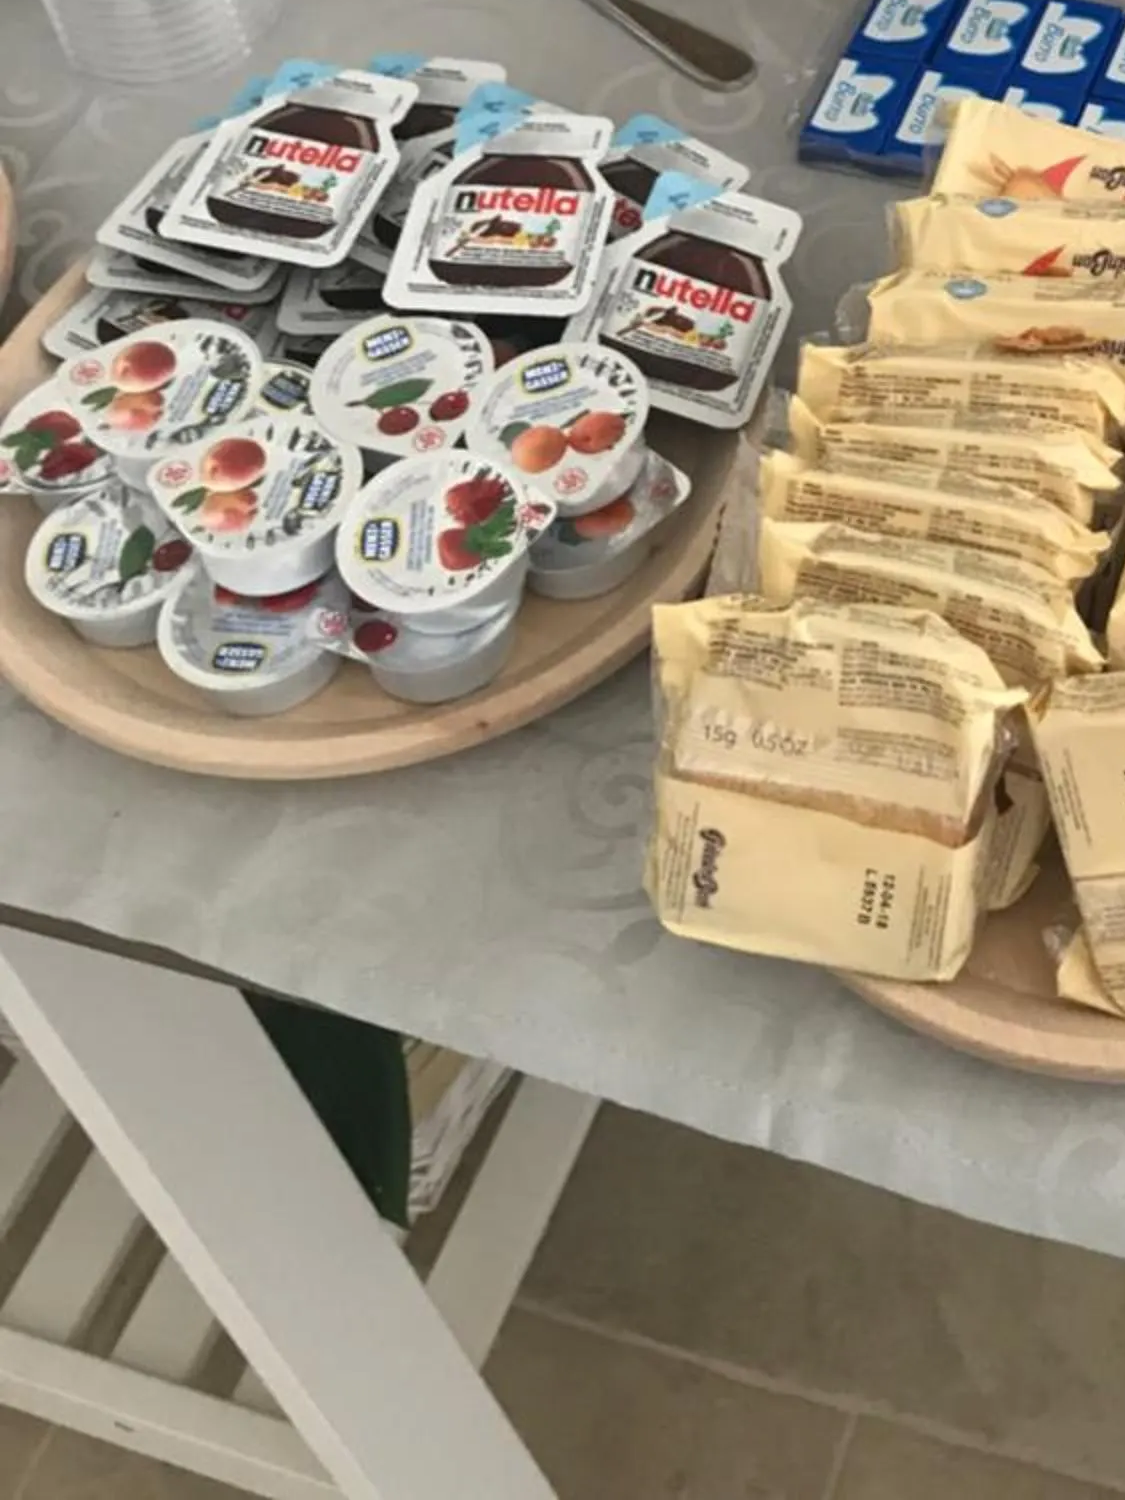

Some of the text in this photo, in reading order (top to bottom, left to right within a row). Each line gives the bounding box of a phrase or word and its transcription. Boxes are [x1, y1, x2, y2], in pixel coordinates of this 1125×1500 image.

[960, 4, 991, 45] Burro
[1034, 22, 1063, 64] Burro
[824, 80, 857, 122] Burro
[243, 134, 361, 174] nutella
[454, 186, 580, 217] nutella
[633, 267, 756, 323] nutella
[702, 724, 737, 748] 15g
